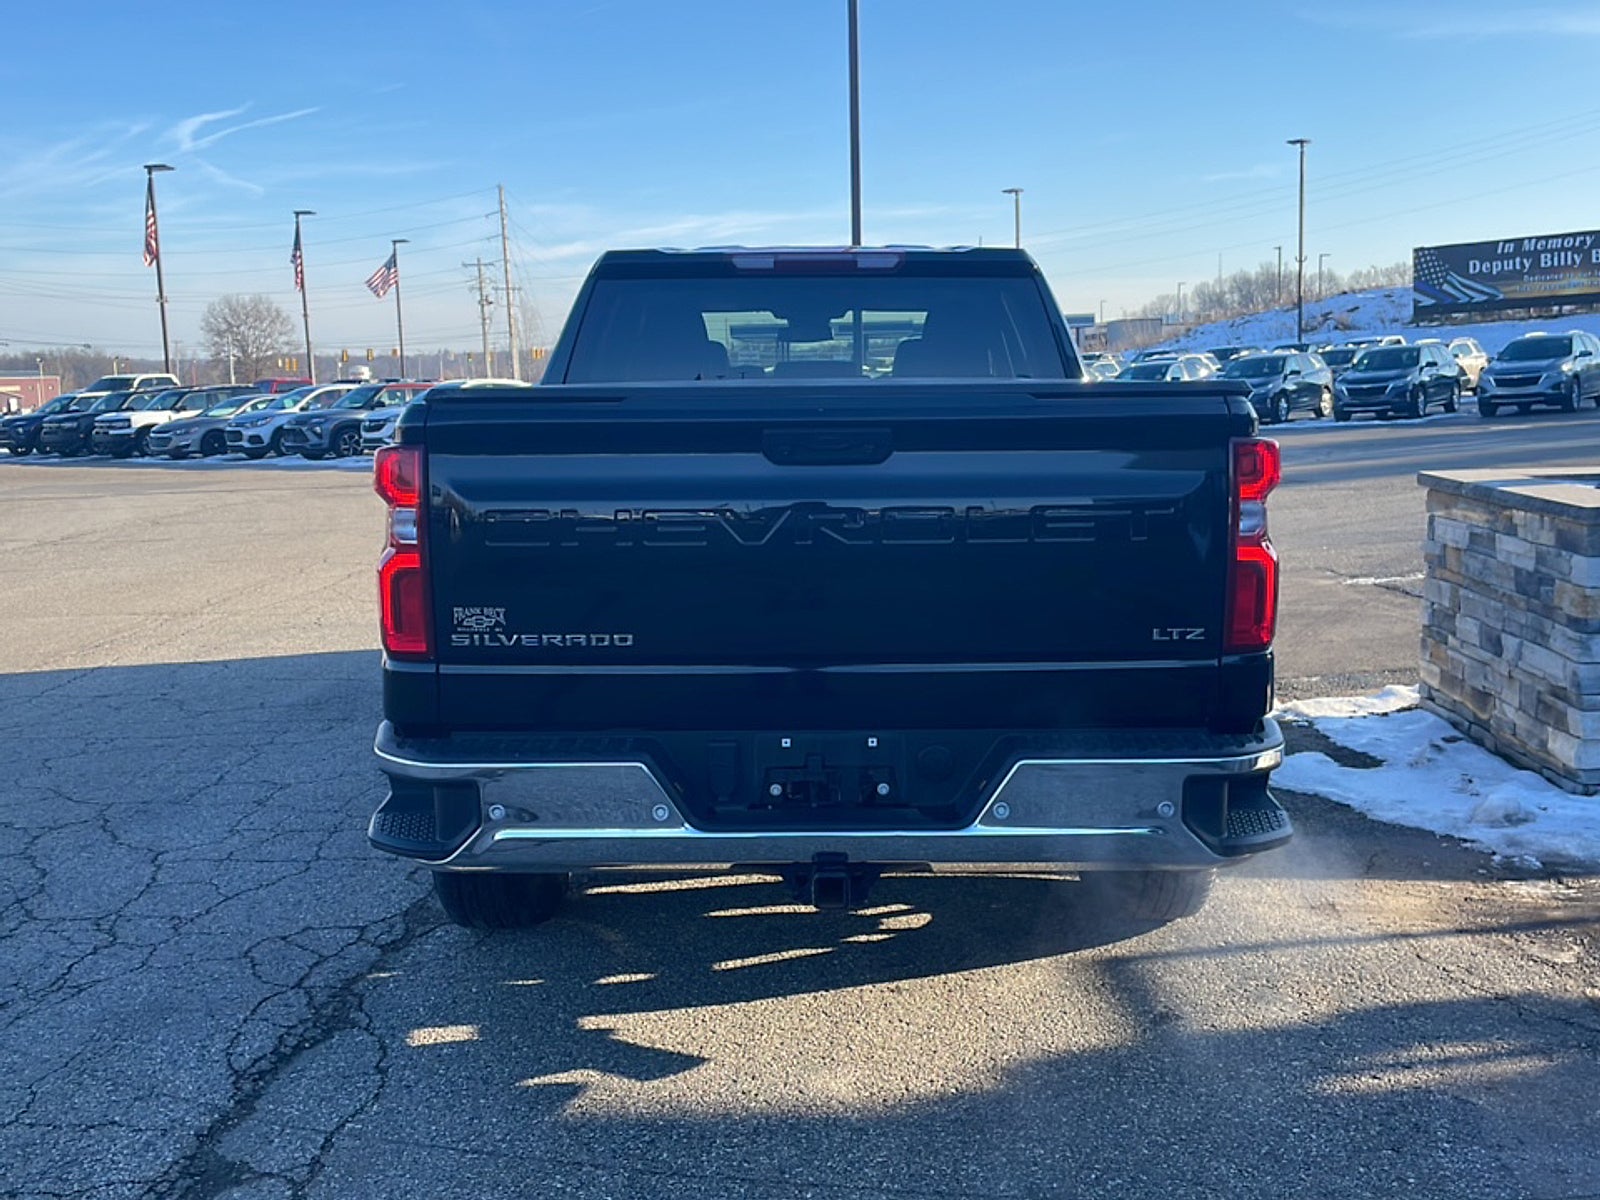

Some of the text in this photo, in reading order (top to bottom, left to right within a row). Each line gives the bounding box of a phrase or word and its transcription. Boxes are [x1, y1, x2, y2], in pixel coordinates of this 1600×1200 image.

[1497, 234, 1595, 254] In Memory
[1469, 256, 1532, 275] Deputy
[1540, 251, 1583, 268] Billy
[483, 503, 1176, 545] CHEVROLET
[451, 634, 634, 647] SILVERADO
[1152, 628, 1206, 641] LTZ
